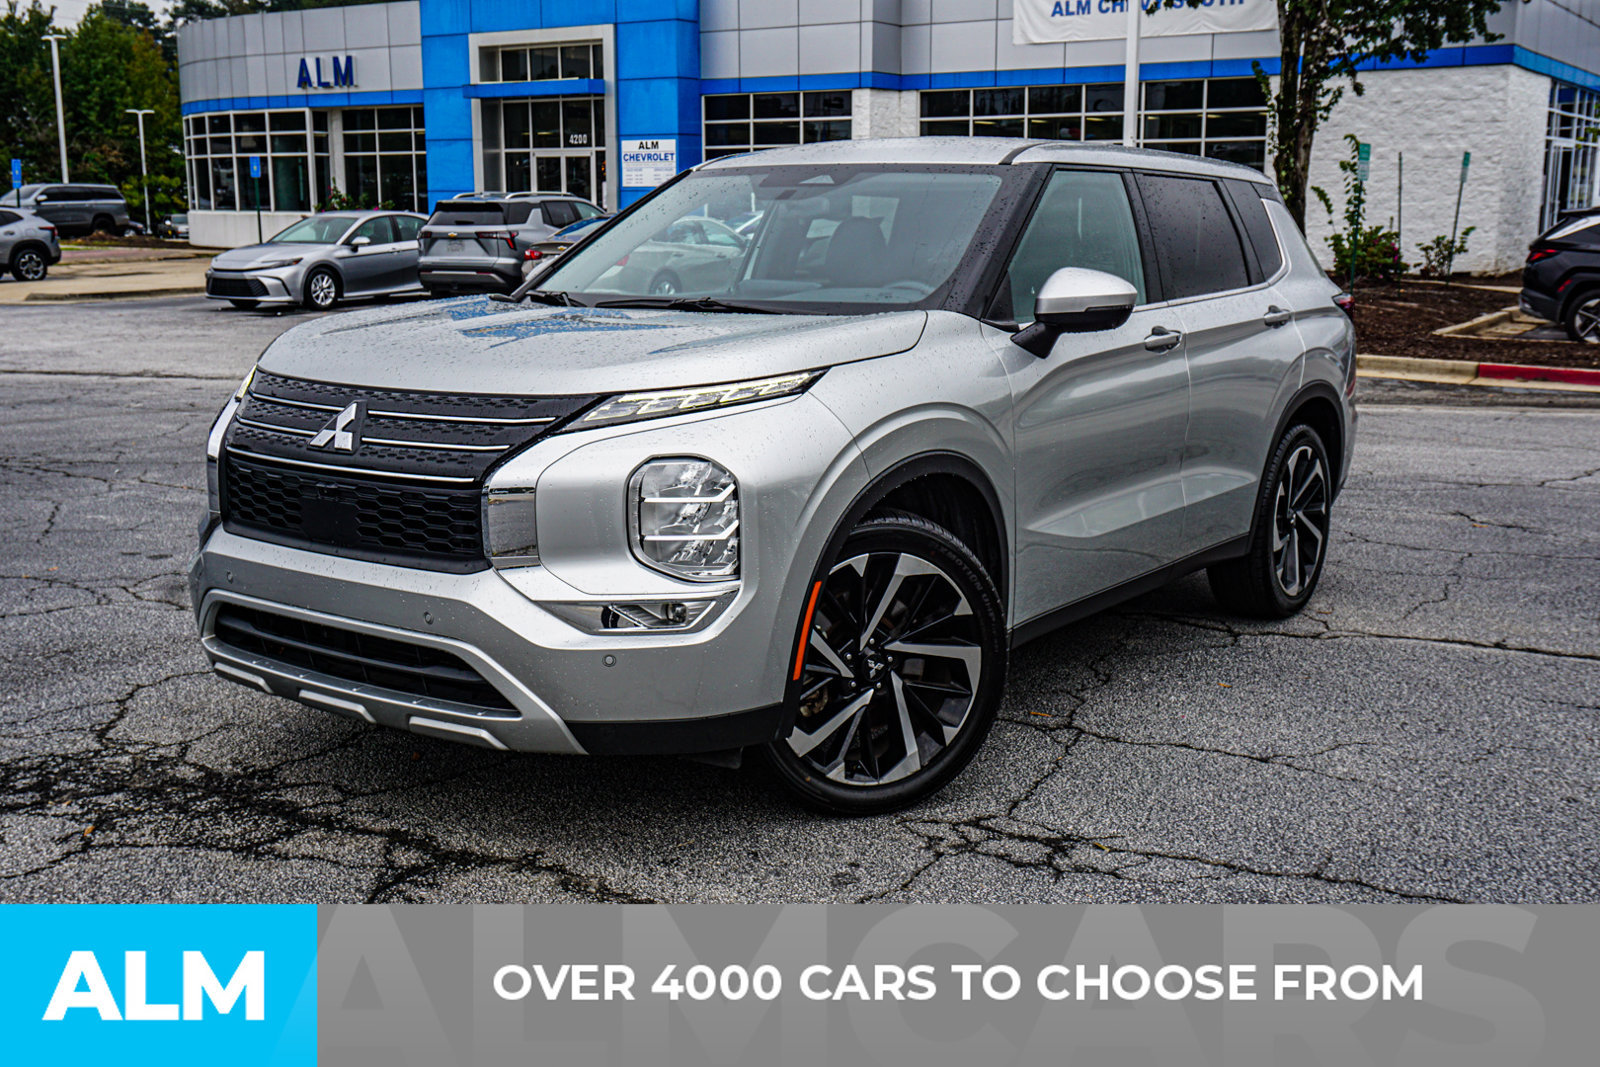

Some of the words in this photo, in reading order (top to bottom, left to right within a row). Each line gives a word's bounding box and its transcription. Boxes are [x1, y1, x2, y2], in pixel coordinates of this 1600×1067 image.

[1051, 0, 1091, 17] ALM
[297, 55, 355, 89] ALM
[569, 134, 588, 144] 4200
[638, 141, 659, 150] ALM
[623, 152, 675, 161] CHEVROLET
